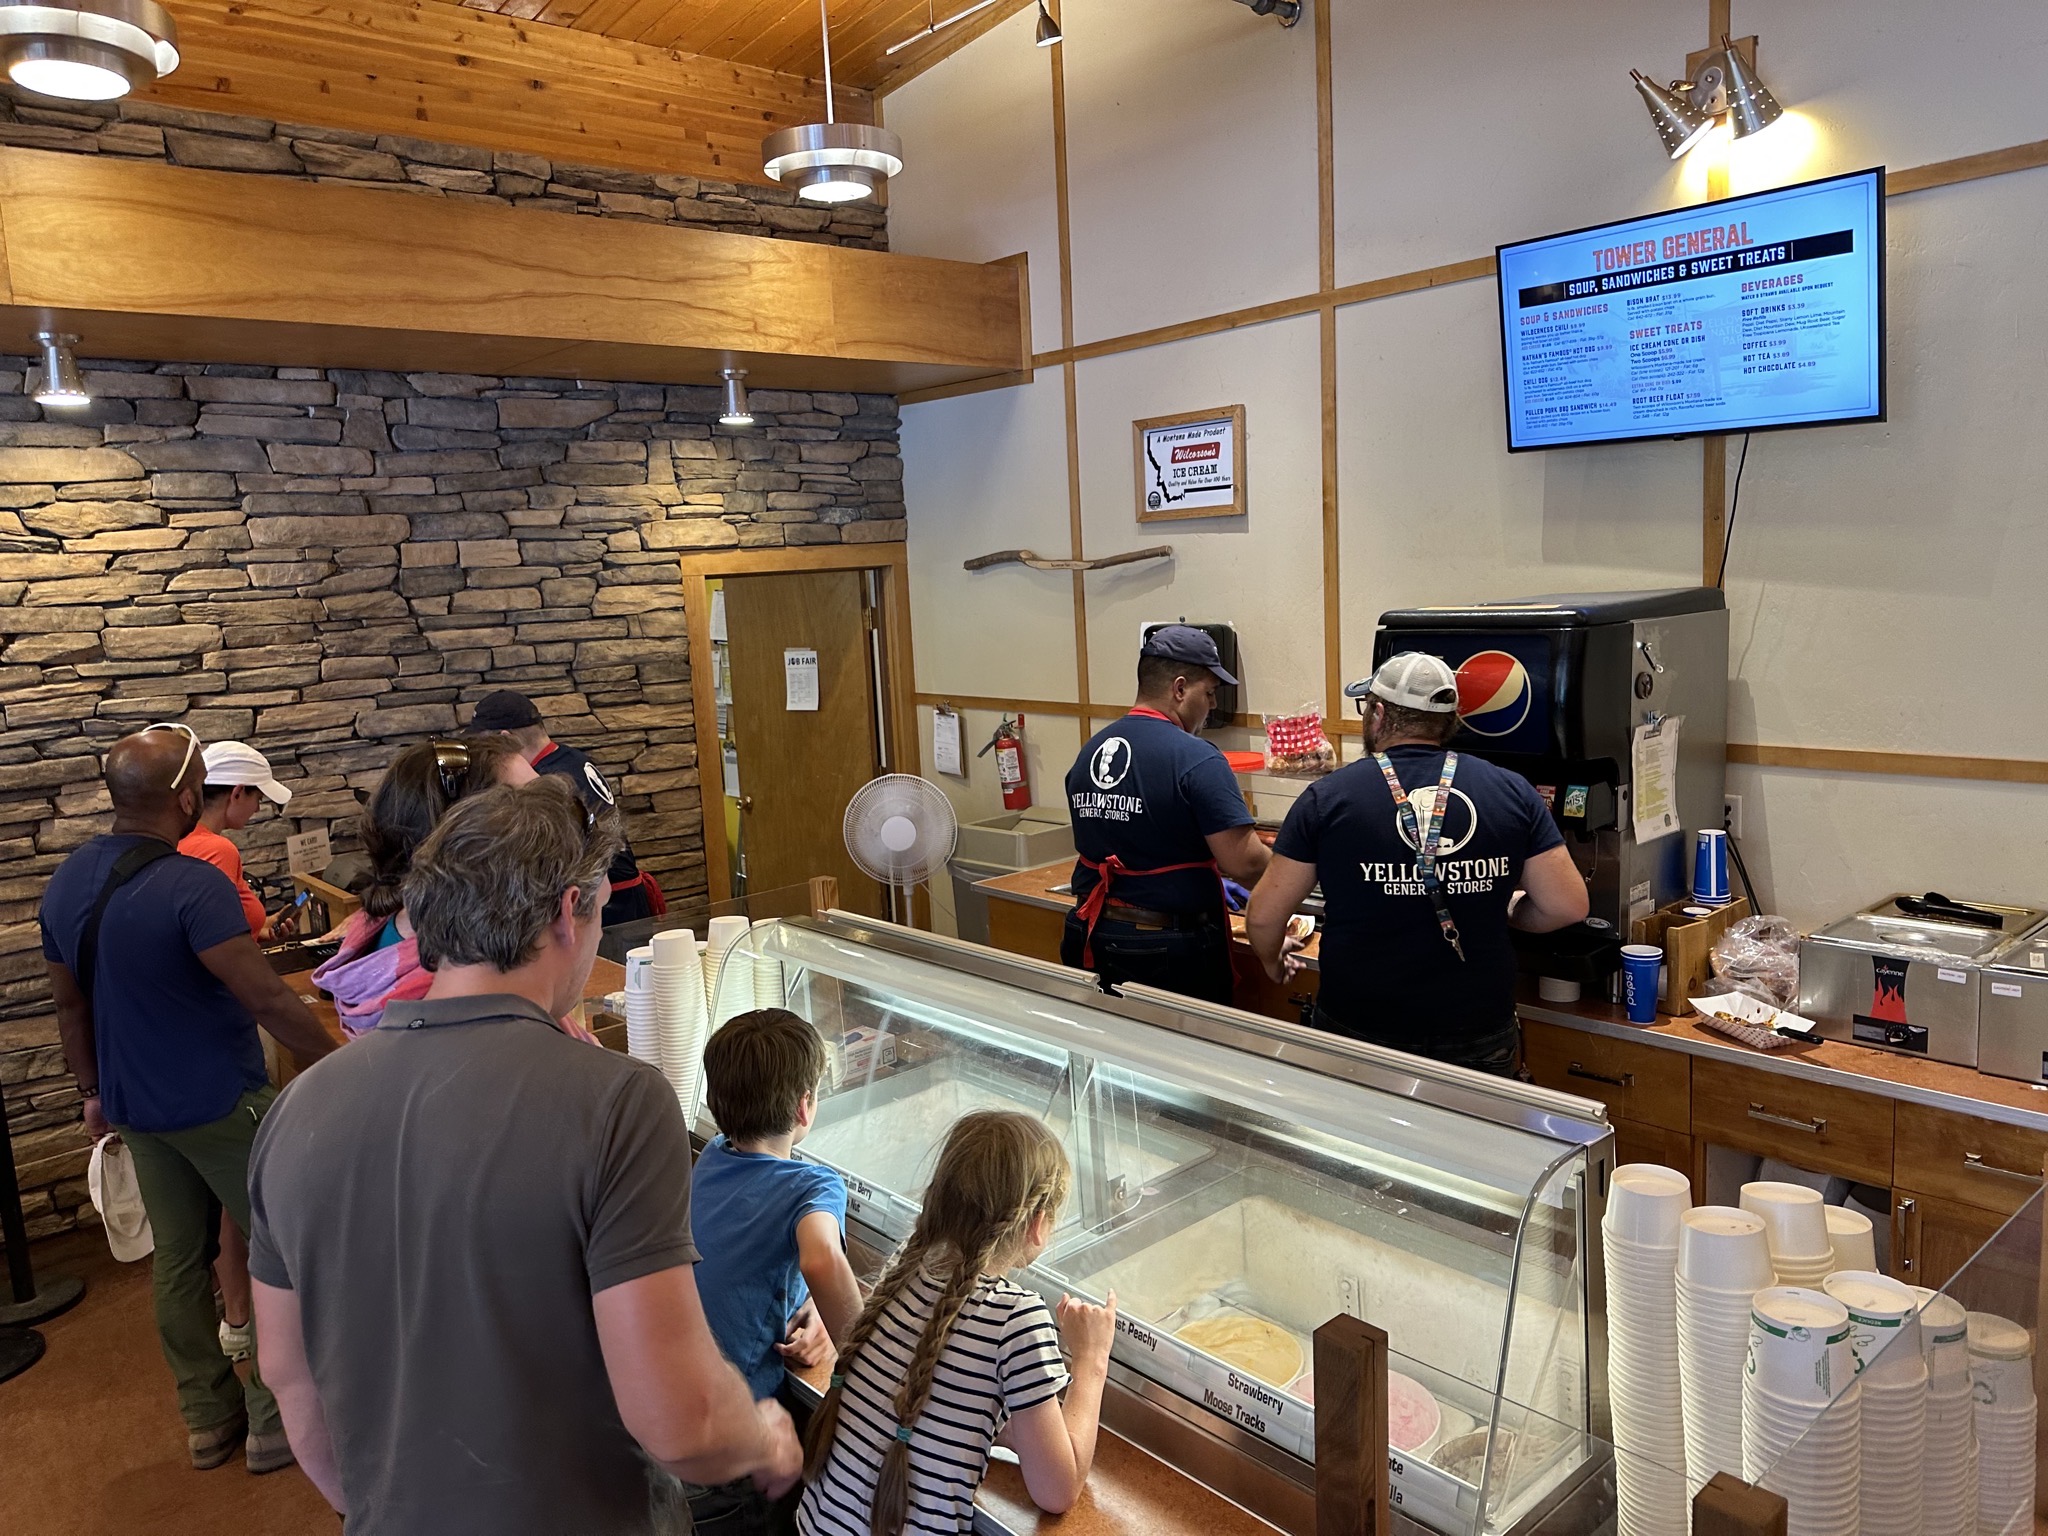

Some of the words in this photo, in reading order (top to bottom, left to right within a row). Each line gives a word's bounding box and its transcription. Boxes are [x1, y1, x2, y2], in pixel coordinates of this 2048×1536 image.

[1593, 240, 1657, 272] TOWER
[1662, 222, 1754, 259] GENERAL
[1569, 280, 1598, 296] SOUP,
[1601, 266, 1675, 290] SANDWICHES
[1679, 263, 1687, 276] &
[1691, 255, 1733, 275] SWEET
[1738, 246, 1786, 267] TREATS
[1741, 274, 1804, 293] BEVERAGES
[1626, 297, 1643, 306] BISON
[1645, 294, 1659, 302] BRAT
[1520, 314, 1541, 326] SOUP
[1543, 311, 1549, 322] &
[1552, 303, 1609, 321] SANDWICHES
[1741, 307, 1758, 317] SOFT
[1760, 303, 1785, 314] DRINKS
[1787, 302, 1804, 310] $3.39
[1554, 323, 1568, 331] CHILI
[1629, 326, 1662, 340] SWEET
[1665, 320, 1703, 334] TREATS
[1629, 343, 1639, 351] ICE
[1641, 340, 1661, 349] CREAM
[1663, 338, 1678, 346] CONE
[1681, 336, 1688, 344] OR
[1691, 334, 1705, 342] DISH
[1742, 340, 1767, 350] COFFEE
[1742, 354, 1755, 362] HOT
[1758, 352, 1770, 360] TEA
[1743, 366, 1756, 374] HOT
[1758, 361, 1795, 372] CHOCOLATE
[1632, 396, 1647, 404] ROOT
[1648, 394, 1663, 402] BEER
[1665, 392, 1684, 400] FLOAT
[1525, 408, 1543, 416] PULLED
[1544, 406, 1557, 414] PORK
[1570, 402, 1597, 411] SANDWICH
[1162, 433, 1186, 443] Montana
[1187, 430, 1202, 440] Made
[1203, 427, 1226, 437] Product
[1174, 444, 1217, 461] Wilcoxson's
[1173, 468, 1186, 478] ICE
[1188, 464, 1218, 476] CREAM
[788, 657, 800, 666] JOB
[801, 657, 817, 665] FAIR
[1071, 792, 1143, 814] YELLOWSTONE
[1104, 809, 1130, 821] STORES
[1447, 879, 1493, 895] STORES
[1625, 970, 1637, 1007] pepsi
[857, 1181, 873, 1200] Berry
[850, 1198, 860, 1213] Nut
[1127, 1321, 1158, 1352] Peachy
[1228, 1372, 1284, 1416] Strawberry
[1203, 1388, 1234, 1416] Moose
[1235, 1404, 1266, 1433] Tracks
